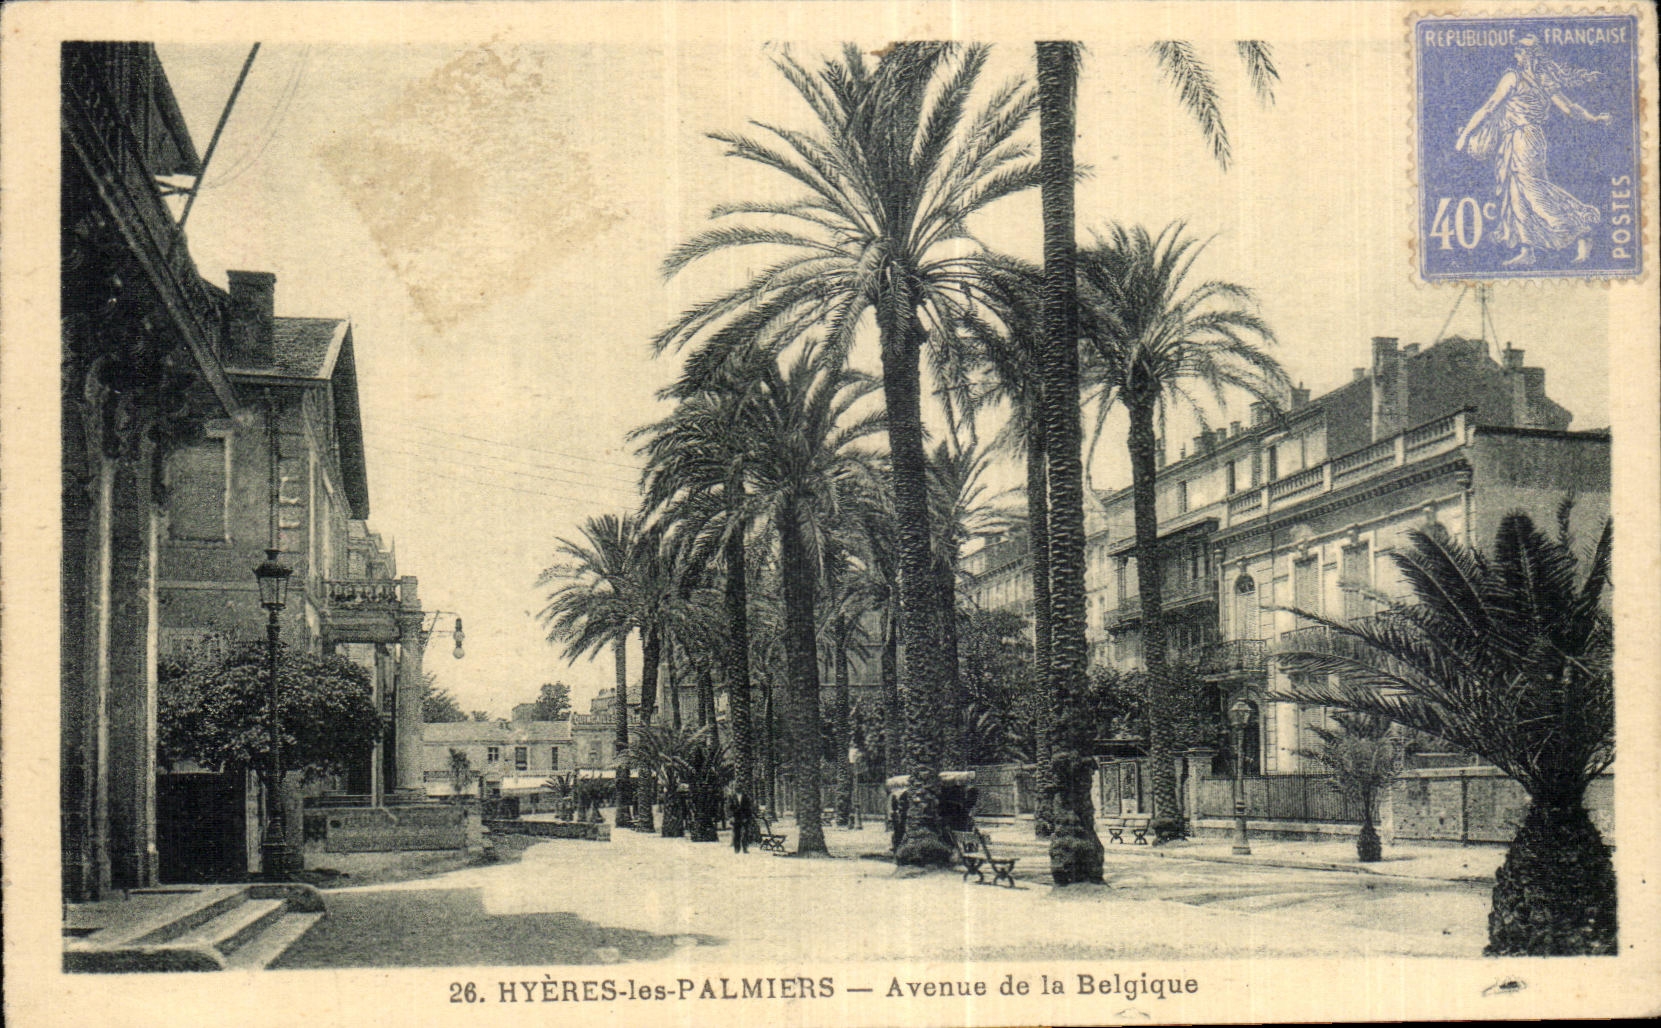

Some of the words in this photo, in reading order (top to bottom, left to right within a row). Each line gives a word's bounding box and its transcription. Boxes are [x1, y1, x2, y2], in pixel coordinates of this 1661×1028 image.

[1425, 28, 1518, 48] REPUBLIQUE
[1543, 26, 1627, 46] FRANÇAISE
[1611, 175, 1631, 259] POSTES
